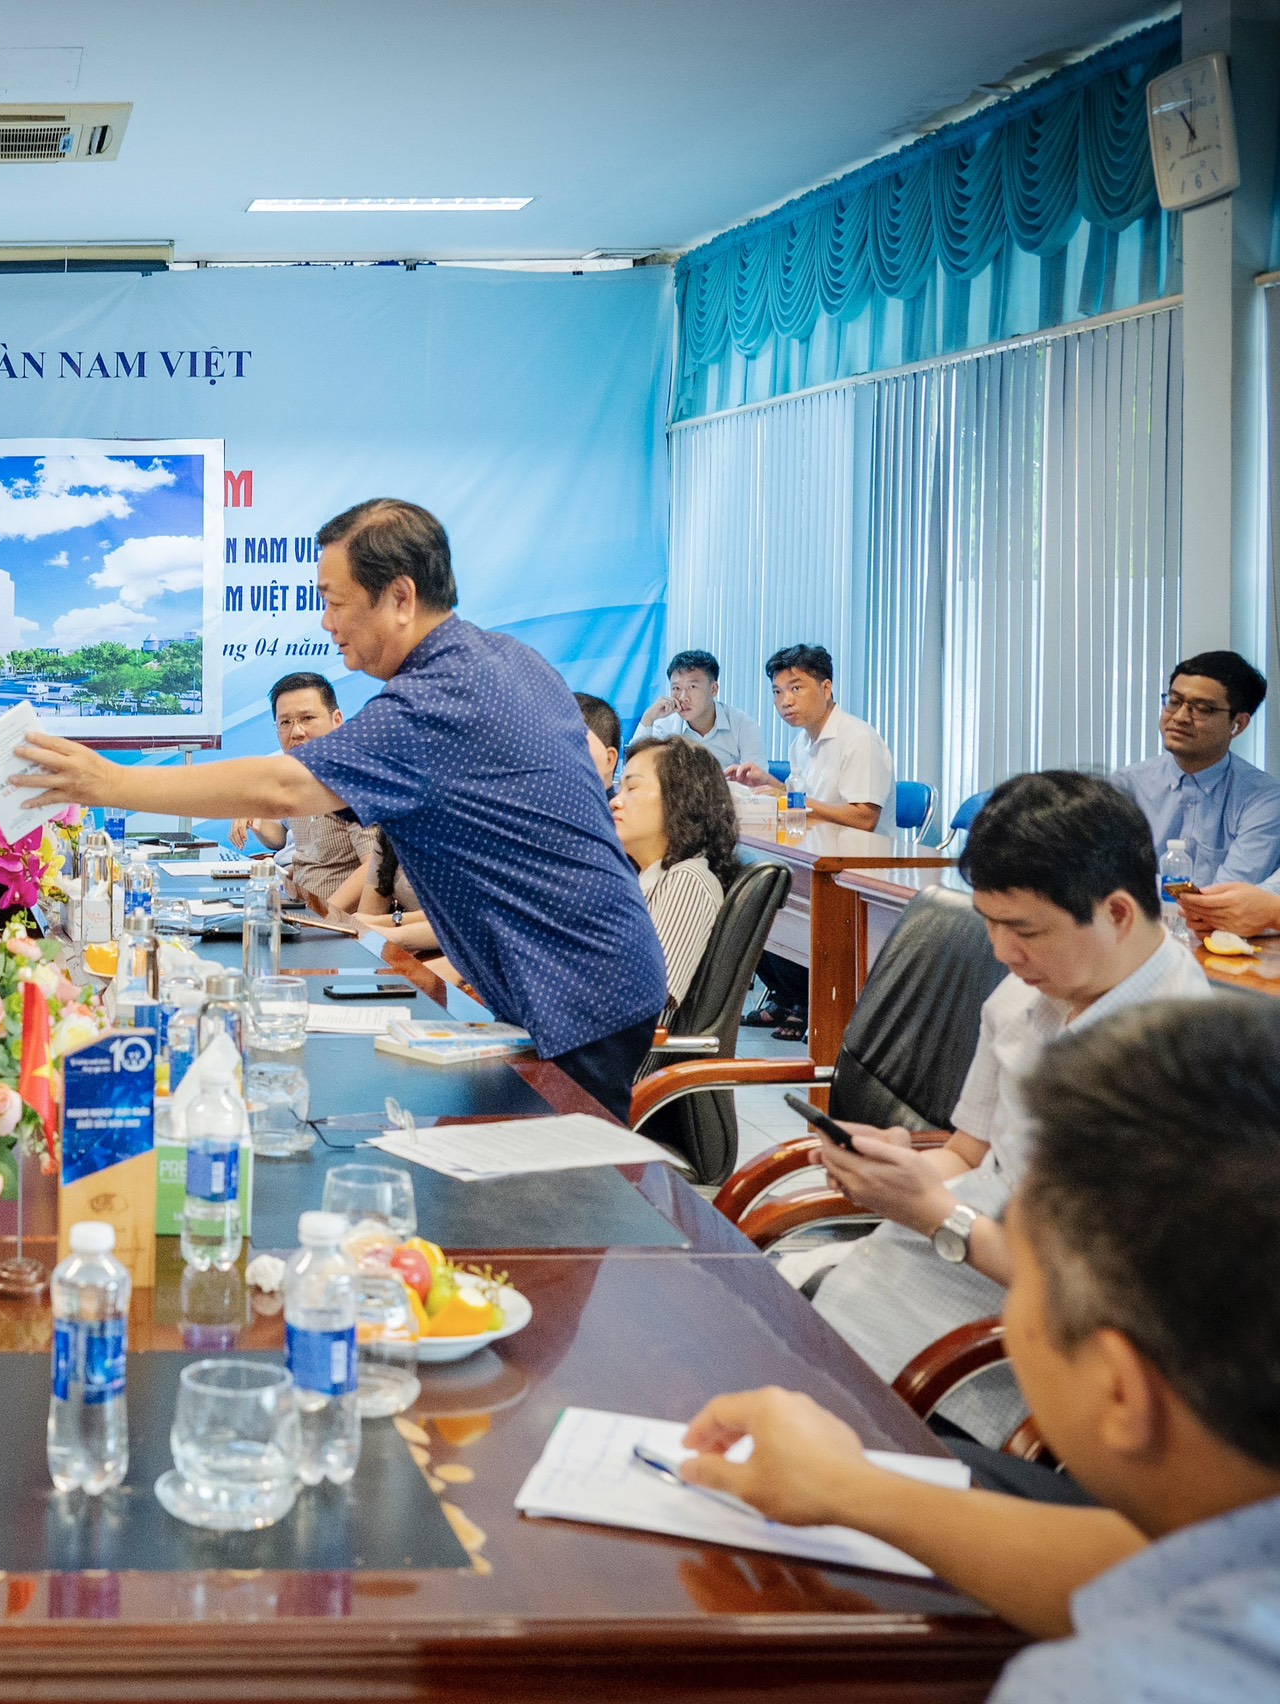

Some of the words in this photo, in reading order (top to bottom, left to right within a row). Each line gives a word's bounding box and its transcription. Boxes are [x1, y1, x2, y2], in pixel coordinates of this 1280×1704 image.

[57, 351, 148, 379] NAM
[158, 346, 252, 386] VIỆT
[244, 537, 288, 563] NAM
[250, 580, 289, 617] VIỆT
[254, 637, 279, 656] 04
[285, 638, 330, 656] năm
[109, 1036, 153, 1073] 10
